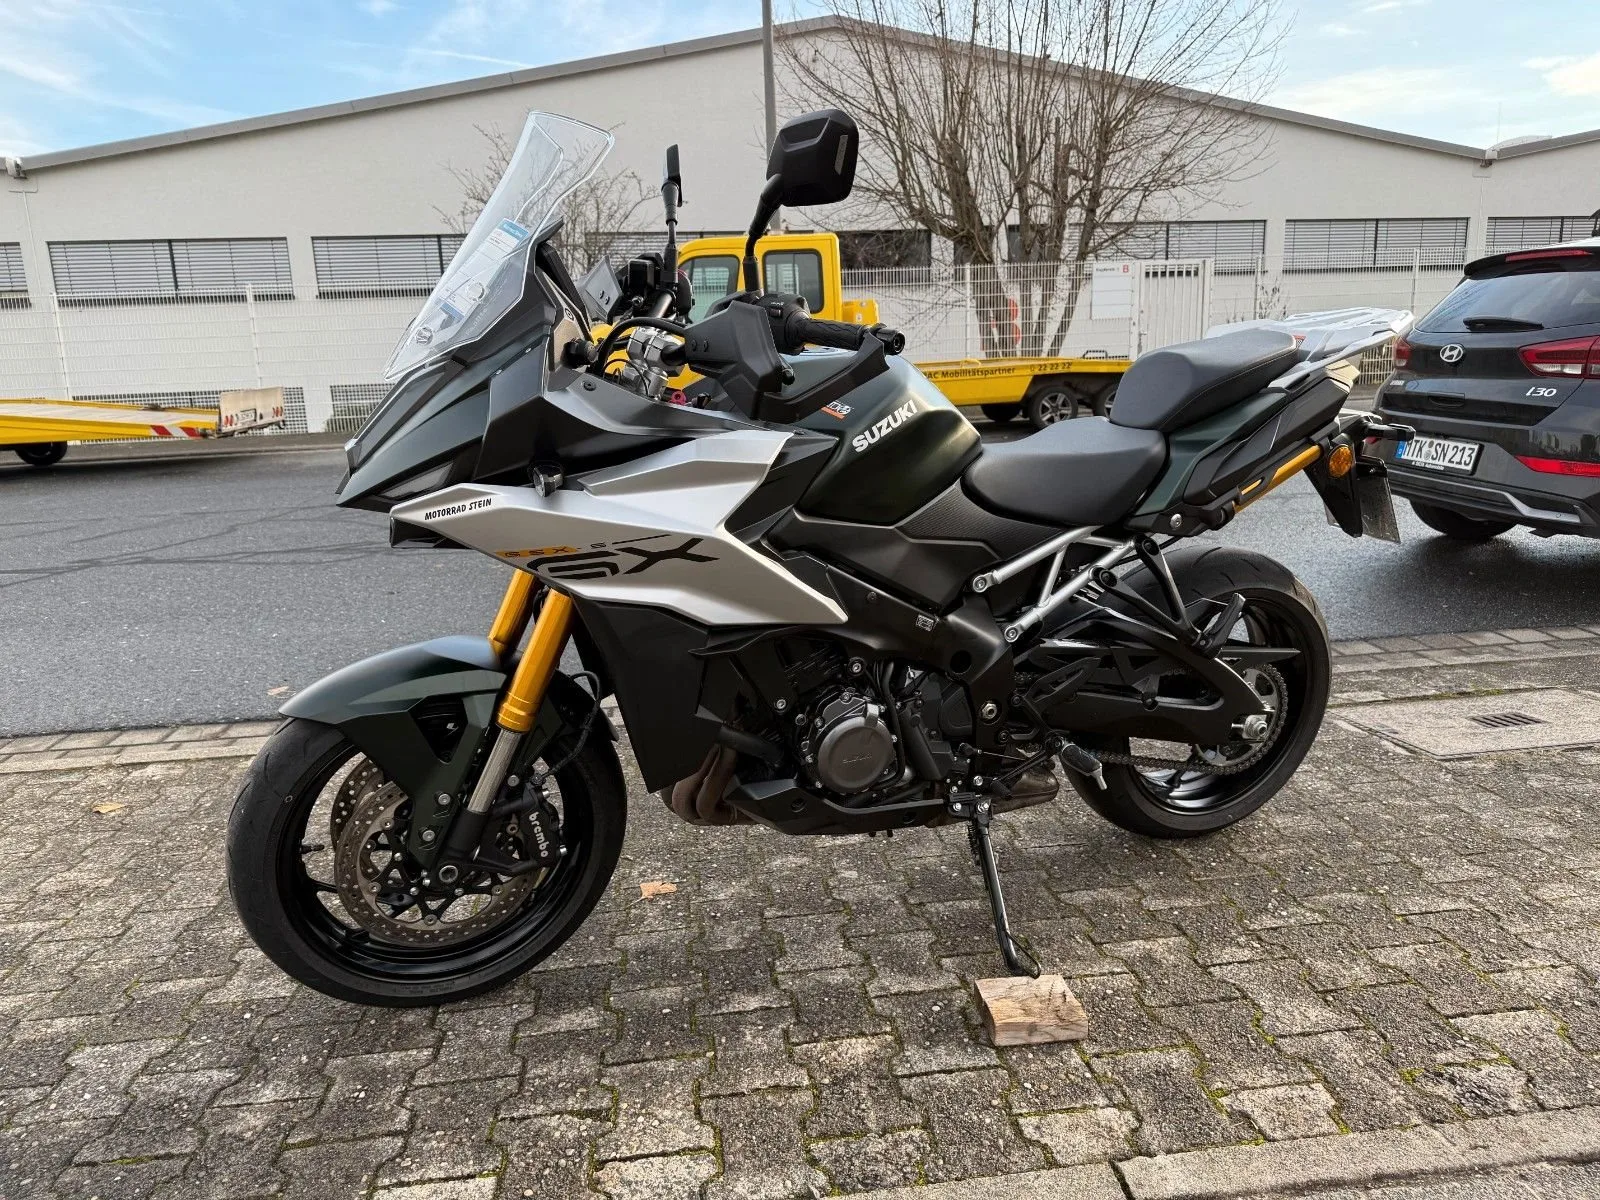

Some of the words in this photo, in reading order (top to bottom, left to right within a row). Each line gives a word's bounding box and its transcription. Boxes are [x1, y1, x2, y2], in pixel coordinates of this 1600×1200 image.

[941, 366, 1016, 379] Mobilitätspartner
[852, 399, 919, 453] SUZUKI
[424, 504, 467, 521] MOTORRAD
[468, 497, 492, 511] STEIN
[528, 811, 550, 858] brembo
